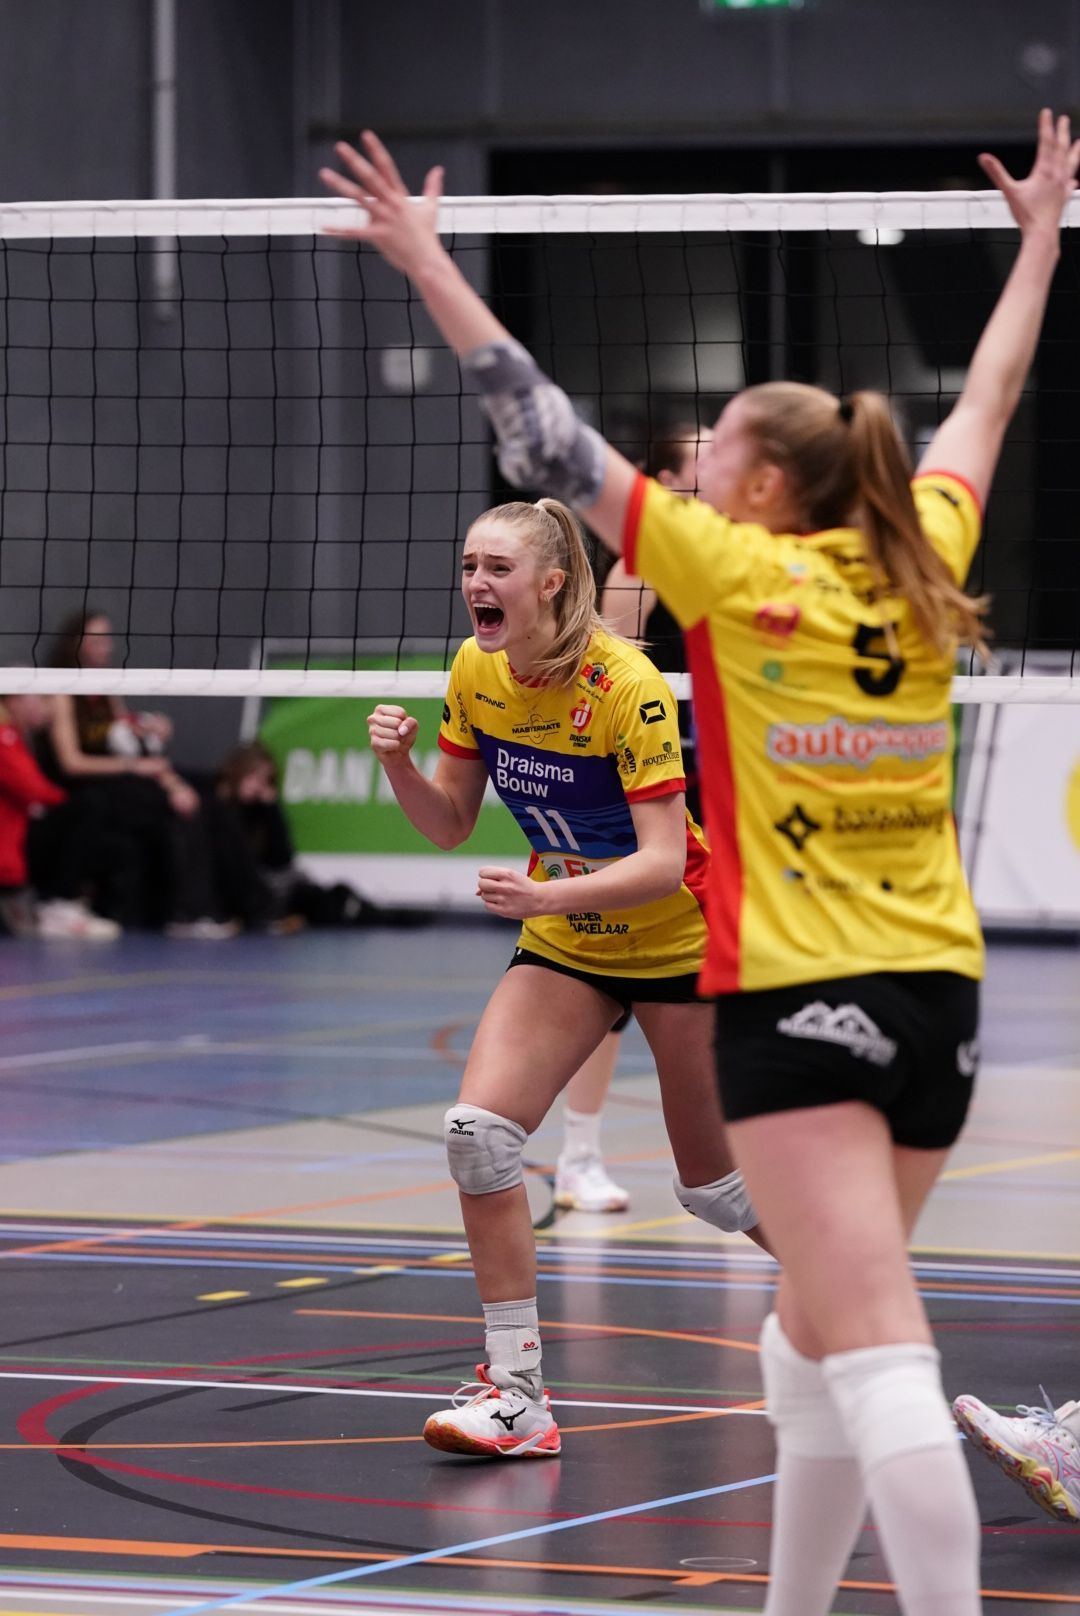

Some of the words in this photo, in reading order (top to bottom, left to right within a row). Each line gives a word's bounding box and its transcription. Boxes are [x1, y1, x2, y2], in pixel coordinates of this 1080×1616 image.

[852, 621, 906, 697] 5
[496, 768, 548, 798] Bouw
[497, 748, 574, 783] Draisma
[525, 806, 581, 851] 11
